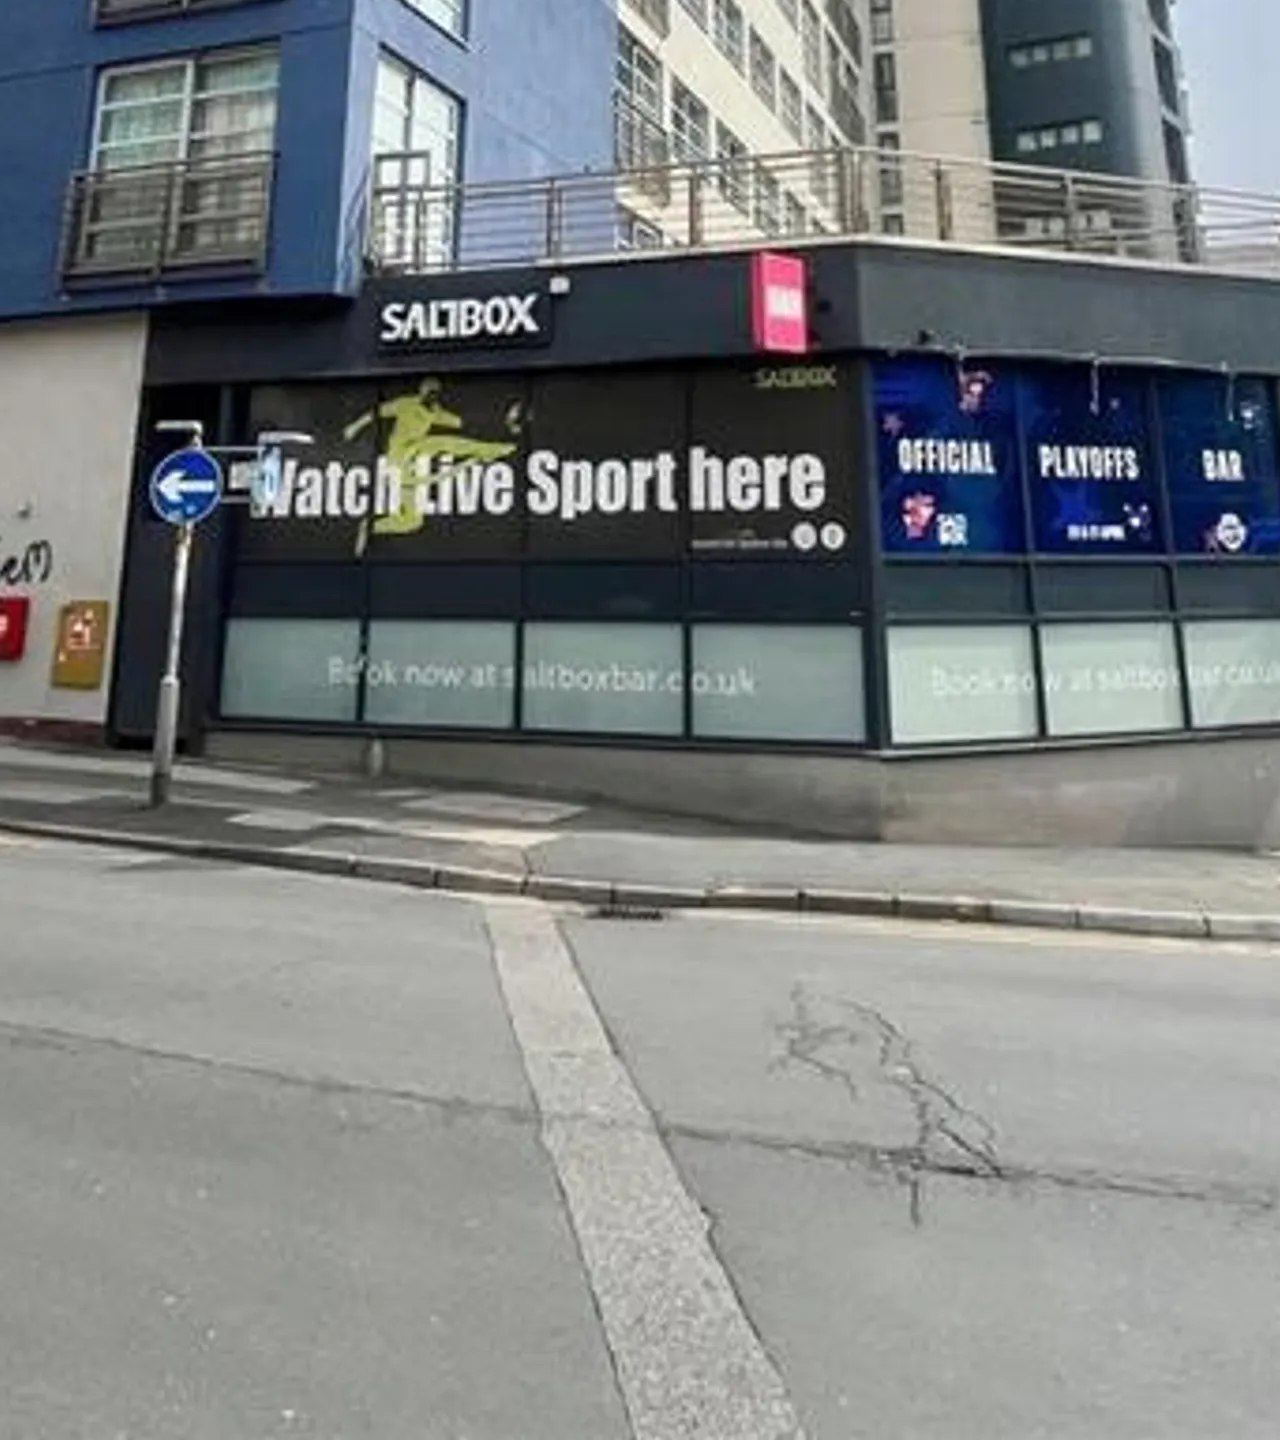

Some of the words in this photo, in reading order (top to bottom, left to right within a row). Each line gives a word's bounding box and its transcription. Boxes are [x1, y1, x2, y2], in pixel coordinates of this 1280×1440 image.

[380, 294, 539, 342] SALTBOX
[898, 438, 996, 475] OFFICIAL
[1038, 444, 1141, 481] PLAYOFFS
[1203, 449, 1245, 482] BAR
[415, 453, 515, 516] Live
[527, 449, 677, 520] Sport
[687, 446, 826, 512] here
[405, 667, 464, 688] now
